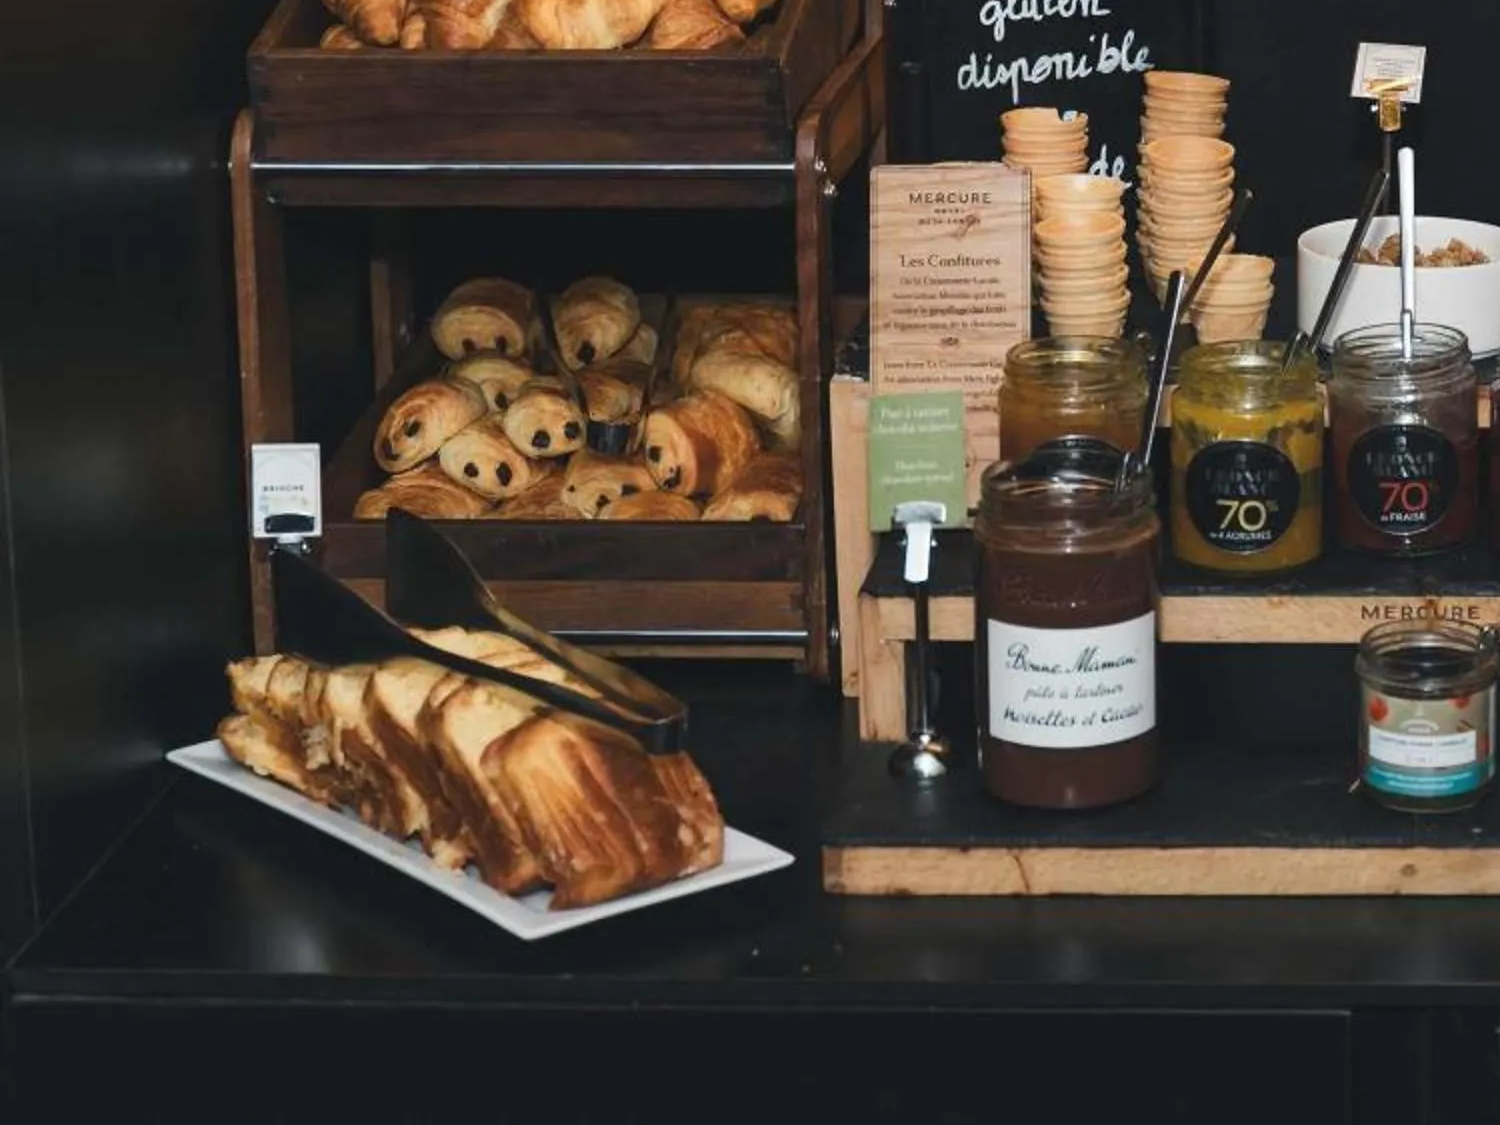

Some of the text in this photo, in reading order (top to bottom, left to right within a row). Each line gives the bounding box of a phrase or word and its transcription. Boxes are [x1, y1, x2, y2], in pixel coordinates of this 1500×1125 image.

[957, 29, 1155, 105] disponible
[909, 191, 993, 205] MERCURE
[900, 254, 1003, 269] Les Confitures
[1360, 604, 1481, 621] MERCURE
[1006, 642, 1138, 674] Bonne Maman
